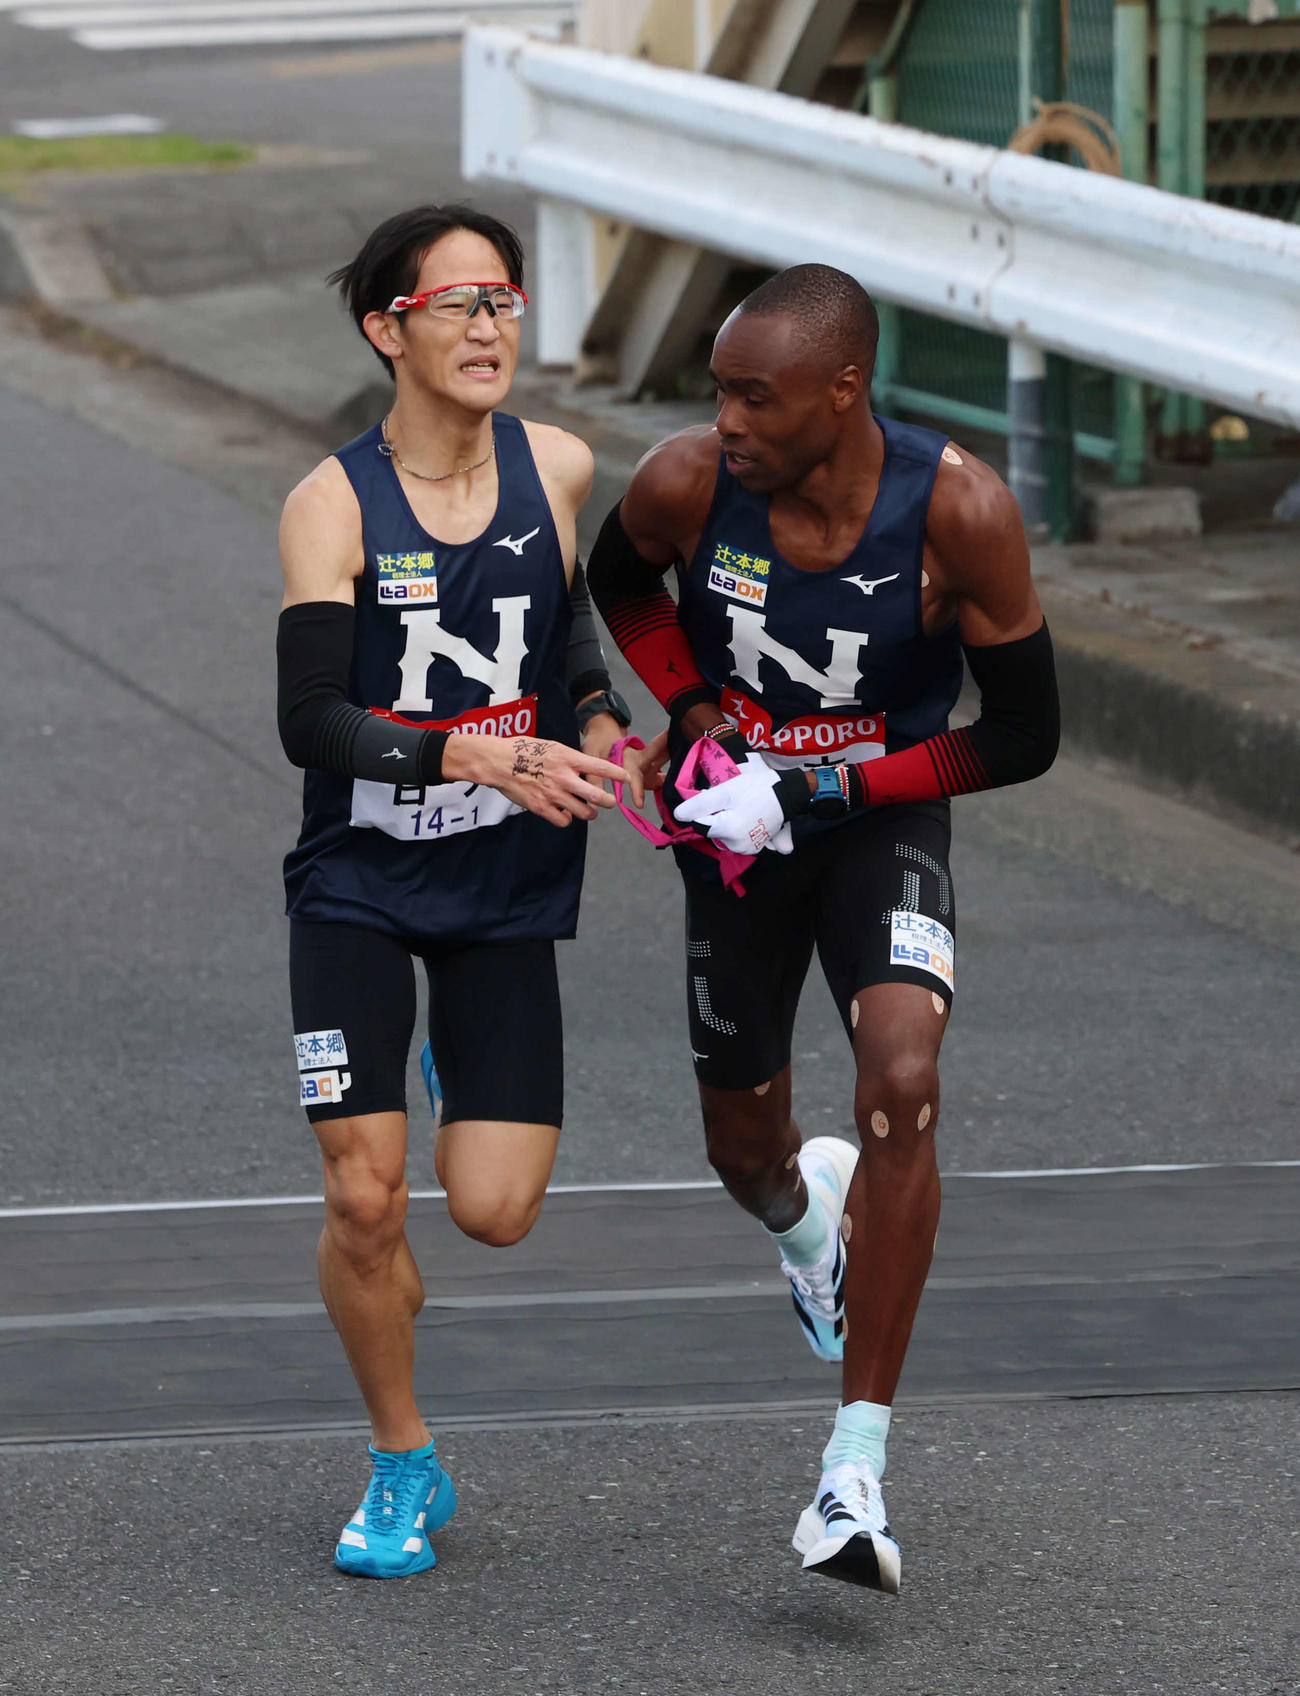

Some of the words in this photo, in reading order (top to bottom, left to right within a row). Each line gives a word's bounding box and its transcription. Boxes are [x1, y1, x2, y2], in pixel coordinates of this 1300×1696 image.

[378, 552, 434, 572] 辻・本郷
[715, 544, 770, 576] 辻・本郷
[391, 595, 531, 712] N
[726, 604, 869, 709] N
[411, 806, 479, 836] 14-1
